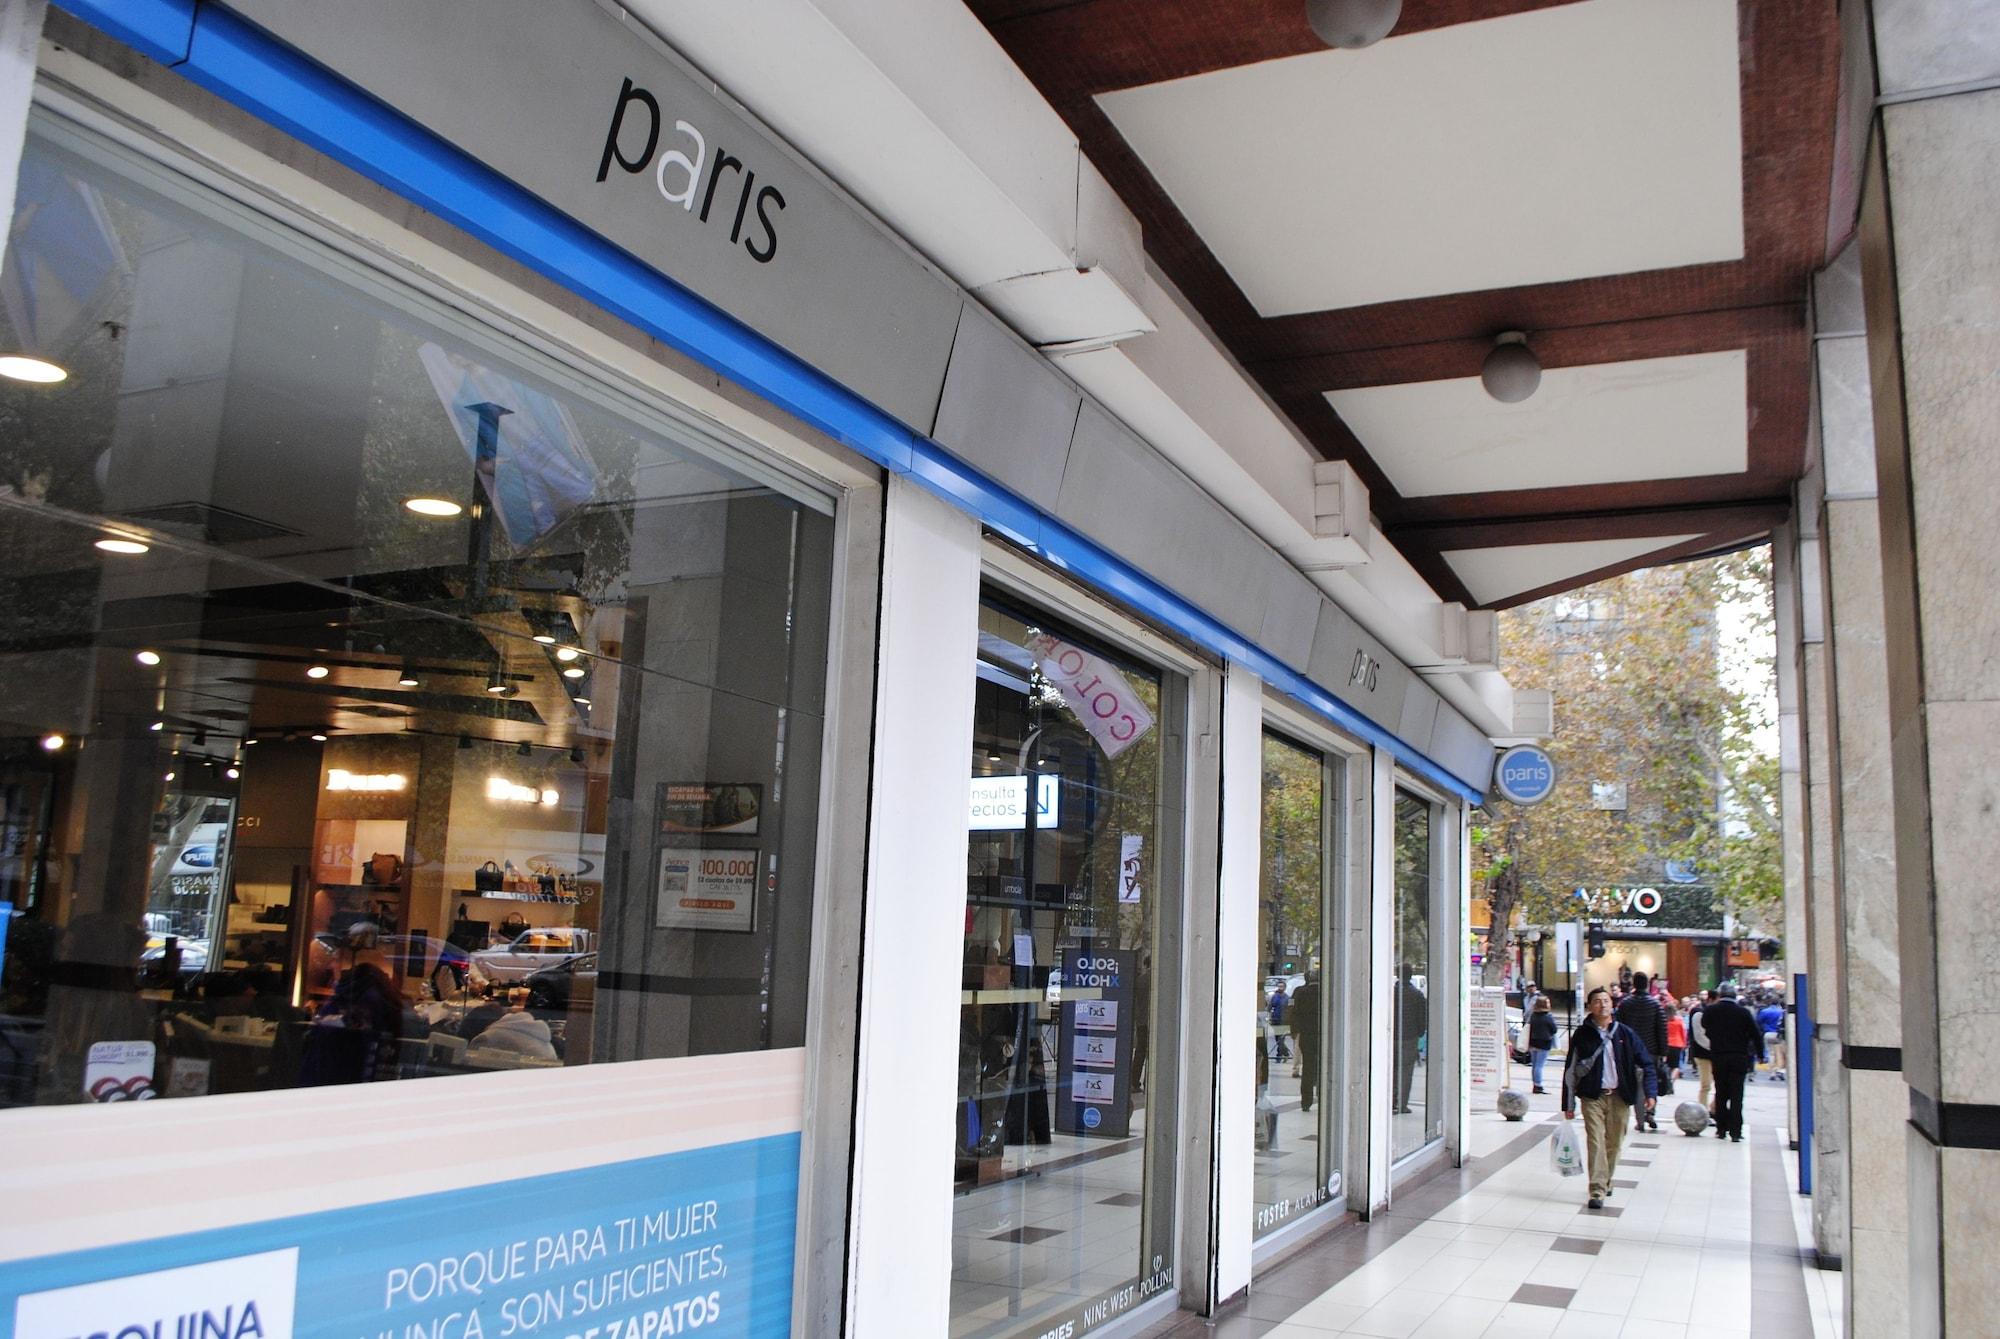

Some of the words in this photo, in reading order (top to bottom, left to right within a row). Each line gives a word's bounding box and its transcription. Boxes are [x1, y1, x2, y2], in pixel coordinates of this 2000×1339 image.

[596, 76, 786, 263] paris
[1348, 648, 1380, 692] paris
[1505, 767, 1548, 784] paris
[1588, 917, 1648, 927] PANRAMICO
[1257, 1199, 1290, 1230] FOSTER
[385, 1241, 527, 1309] PORQUE
[534, 1225, 607, 1274] PARA
[614, 1216, 636, 1252] TI
[641, 1200, 718, 1248] MUJER
[359, 1308, 485, 1339] NCA
[501, 1285, 565, 1336] SON
[572, 1244, 728, 1317] SUFICIENTES,
[1083, 1300, 1108, 1329] NINE
[1110, 1285, 1134, 1314] WEST
[1140, 1267, 1173, 1297] POLLINI
[66, 1300, 264, 1339] UINA
[604, 1291, 721, 1339] ZAPATOS
